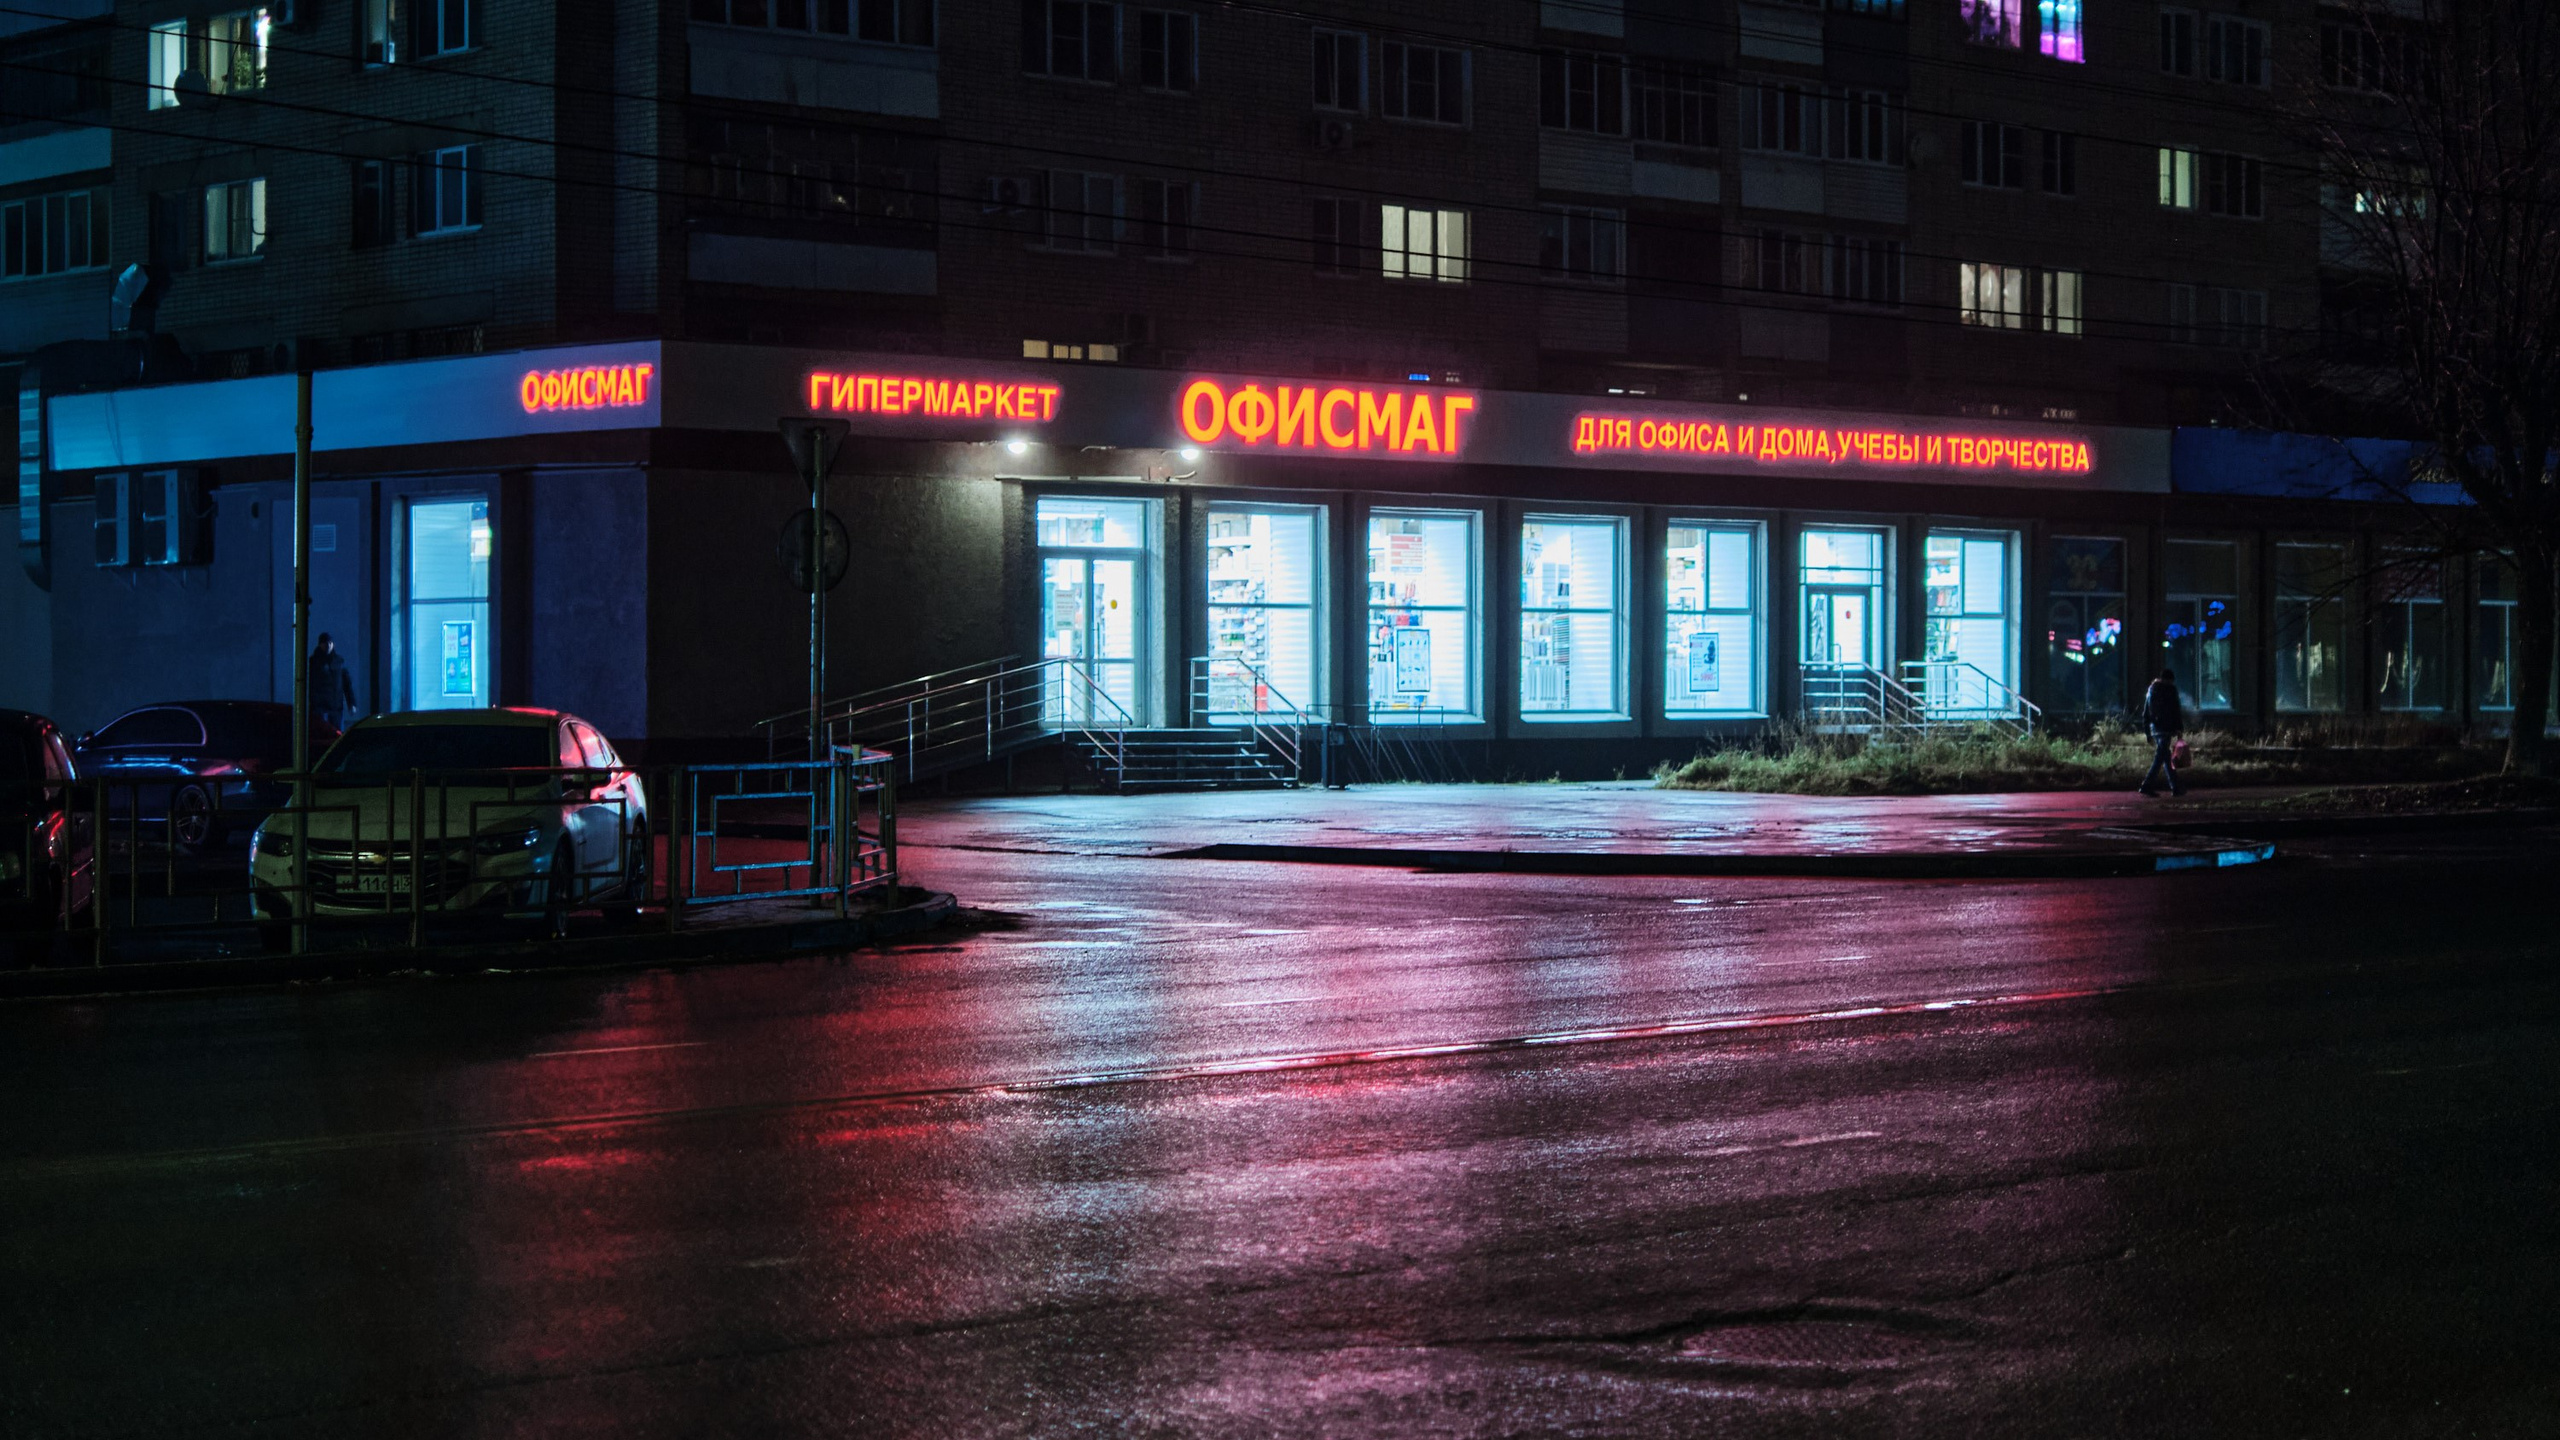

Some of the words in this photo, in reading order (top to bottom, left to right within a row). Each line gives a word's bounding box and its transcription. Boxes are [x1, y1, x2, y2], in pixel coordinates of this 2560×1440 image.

[521, 364, 653, 412] ОФИСМАГ
[810, 372, 1060, 420] ГИПЕРМАРКЕТ
[1181, 379, 1475, 454] ОФИСМАГ
[1575, 416, 1633, 453] ДЛЯ
[1638, 419, 1731, 454] ОФИСА
[1737, 425, 1756, 455] И
[1836, 430, 1920, 463] УЧЕБЫ
[1925, 435, 1943, 464] И
[1946, 436, 2090, 472] ТВОРЧЕСТВА
